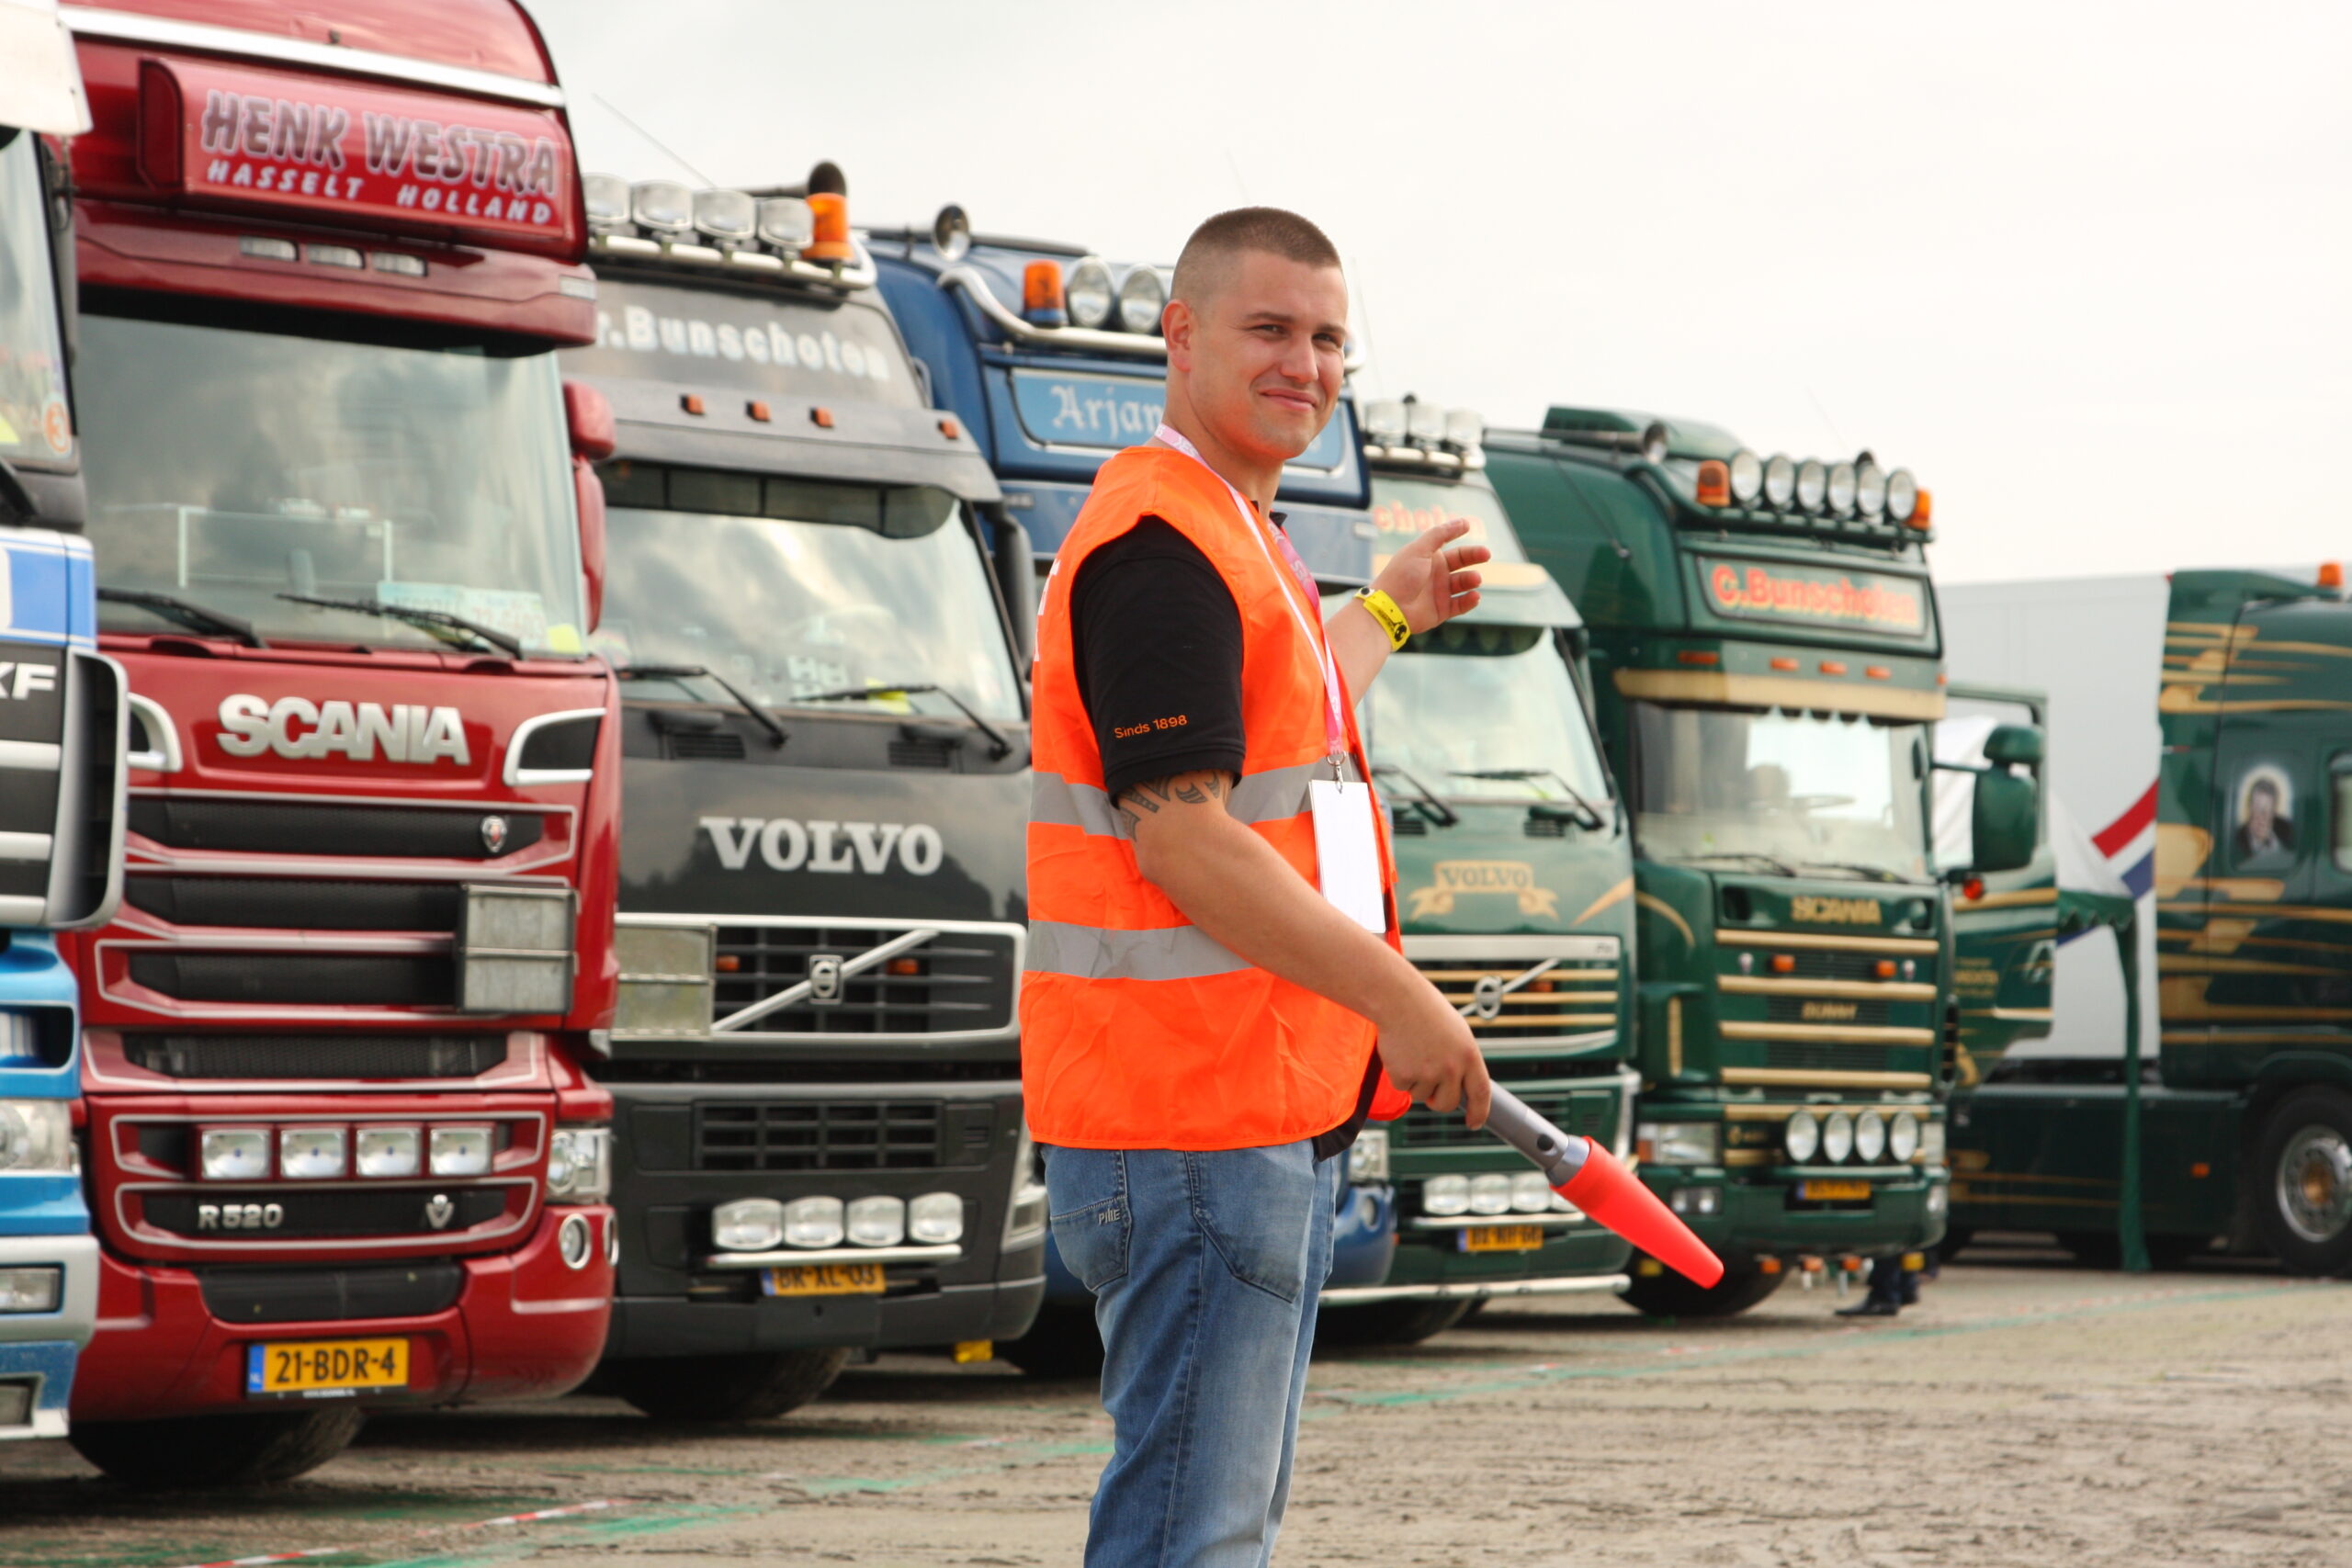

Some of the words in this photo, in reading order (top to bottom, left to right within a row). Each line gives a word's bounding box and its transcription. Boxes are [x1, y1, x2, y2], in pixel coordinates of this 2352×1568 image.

[201, 89, 350, 171] HENK
[363, 110, 556, 197] WESTRA
[207, 159, 364, 200] HASSELT
[396, 183, 552, 225] HOLLAND
[215, 693, 471, 766] SCANIA
[1114, 723, 1151, 739] Sinds
[1152, 715, 1188, 729] 1898
[698, 815, 944, 876] VOLVO
[1441, 865, 1528, 887] VOLVO
[1791, 894, 1883, 925] SCANIA
[277, 1346, 396, 1383] 21-BDR-4
